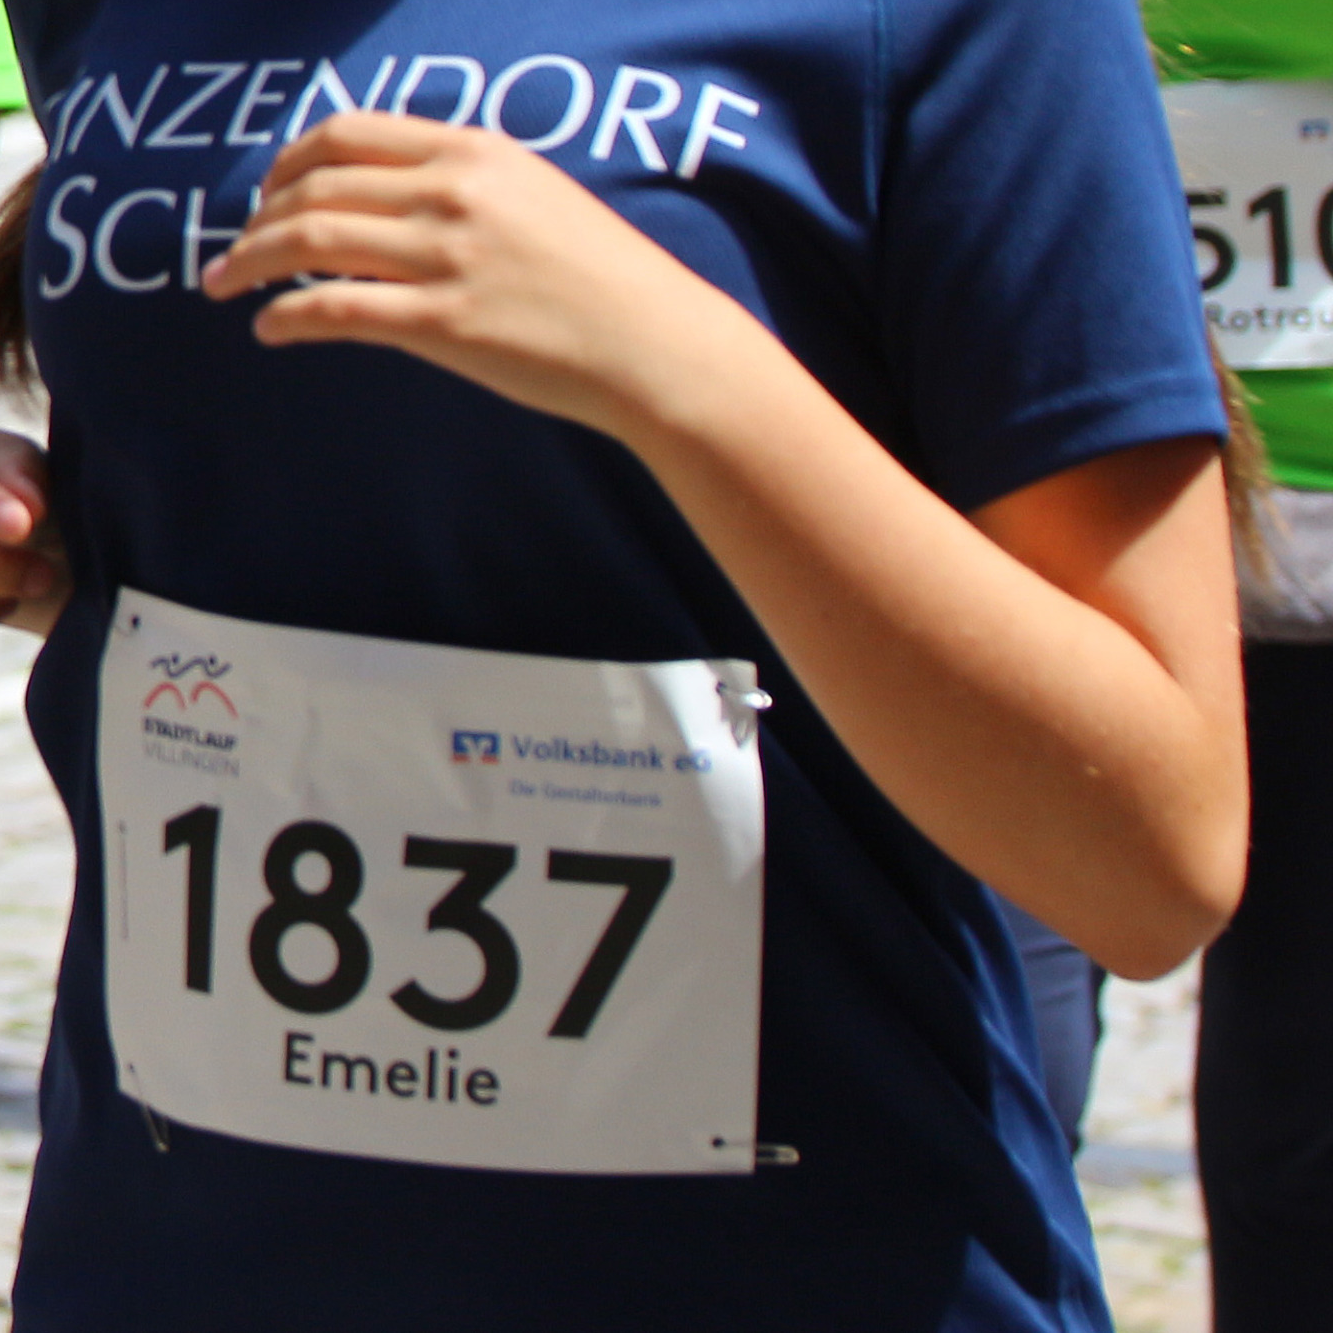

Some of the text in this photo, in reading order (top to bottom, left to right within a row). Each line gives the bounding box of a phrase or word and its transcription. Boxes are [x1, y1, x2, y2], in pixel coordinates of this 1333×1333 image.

[46, 54, 760, 179] INZENDORF
[1186, 184, 1333, 292] 51
[512, 735, 664, 771] Volksbank
[164, 803, 675, 1042] 1837
[282, 1031, 501, 1106] Emelie
